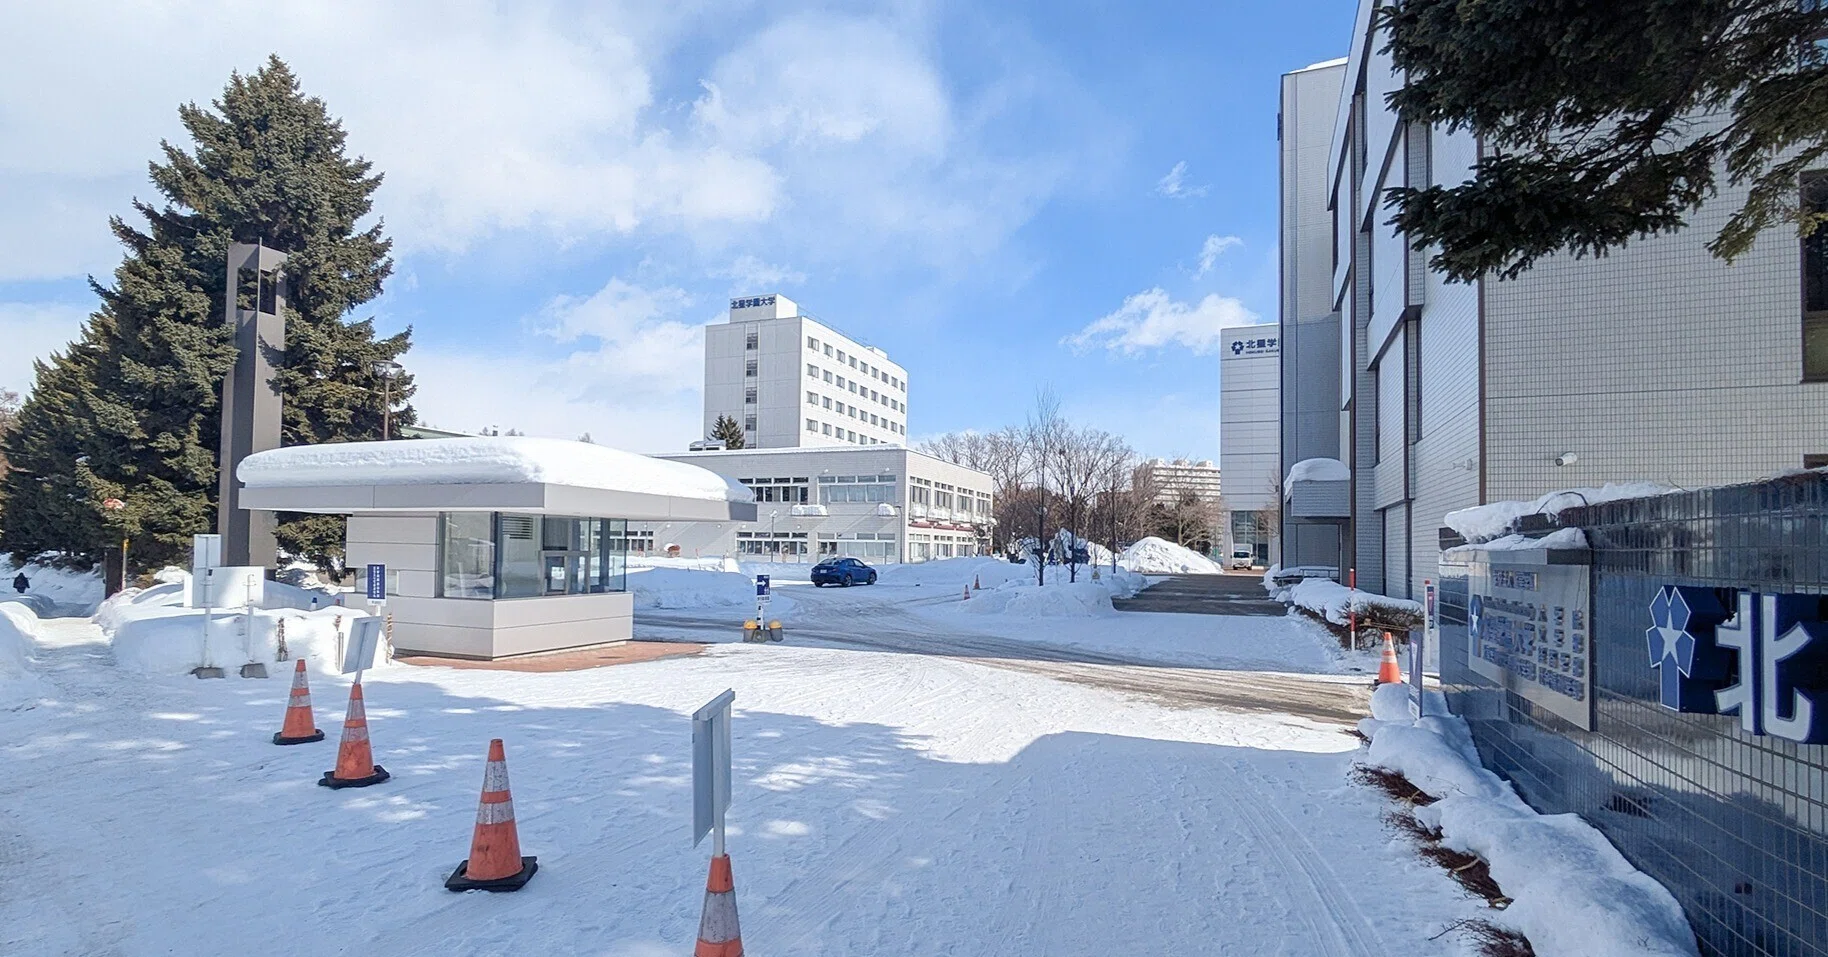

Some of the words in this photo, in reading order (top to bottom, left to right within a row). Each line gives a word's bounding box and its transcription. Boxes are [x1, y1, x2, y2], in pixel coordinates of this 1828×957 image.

[1246, 338, 1279, 348] 北星学
[1714, 592, 1812, 742] 北
